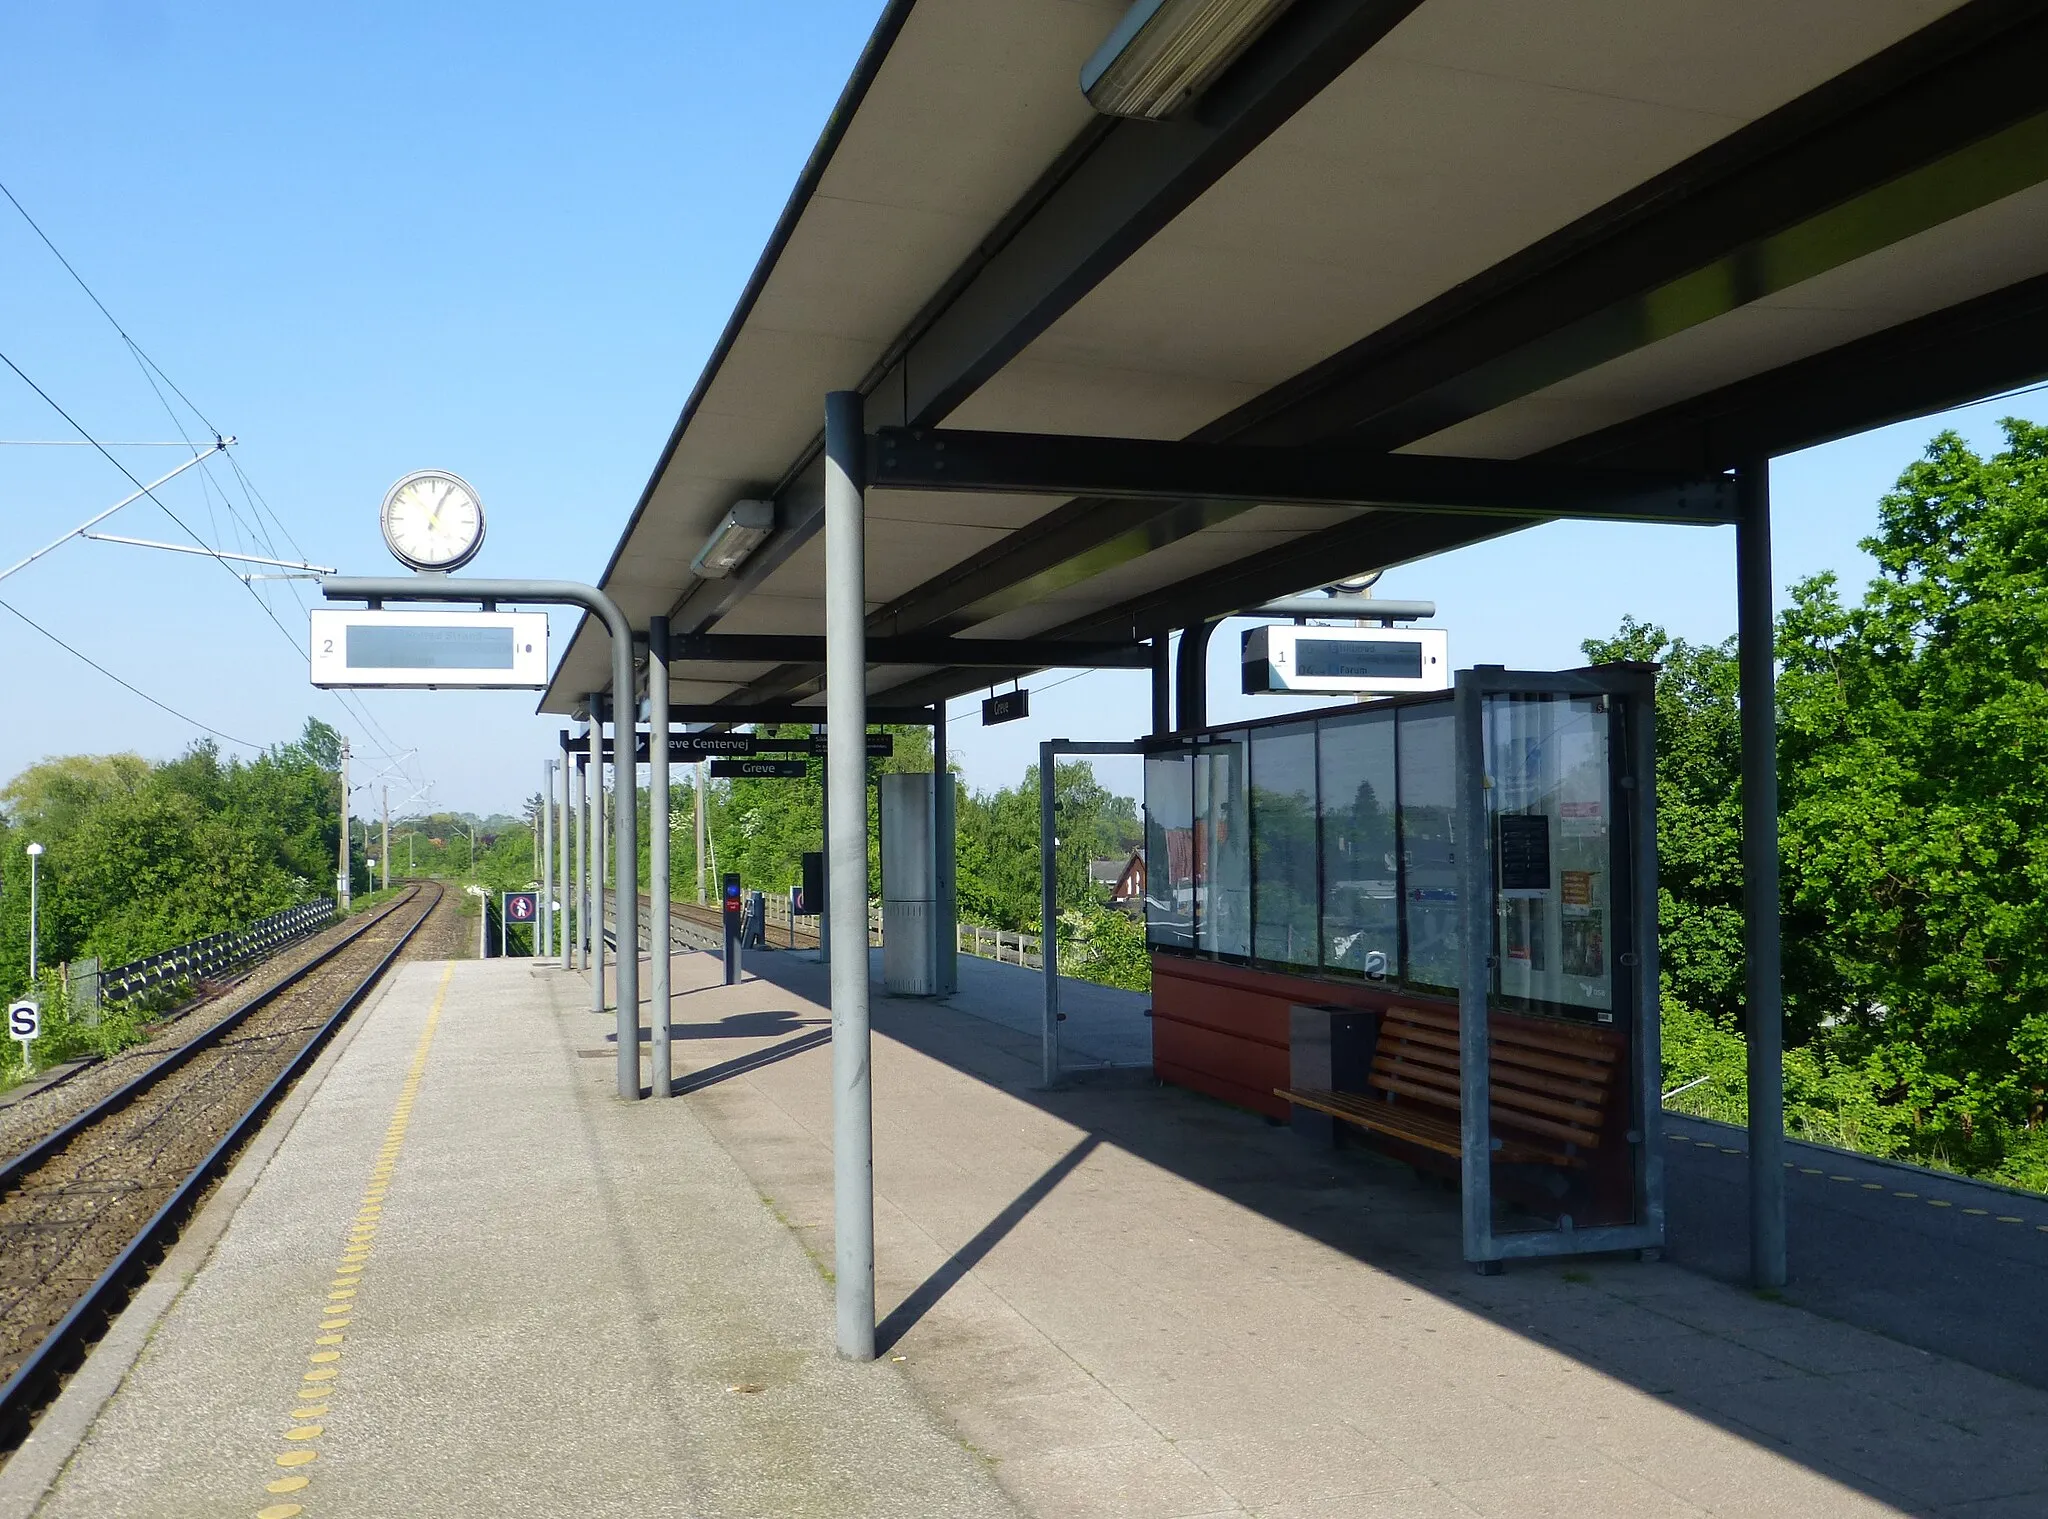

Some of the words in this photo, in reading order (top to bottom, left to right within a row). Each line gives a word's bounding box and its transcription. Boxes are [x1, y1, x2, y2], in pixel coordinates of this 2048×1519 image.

[323, 639, 333, 653] 2
[1278, 651, 1286, 663] 1
[994, 700, 1009, 716] Greve
[668, 740, 689, 749] eve
[692, 738, 749, 751] Centervej
[742, 763, 776, 773] Greve
[11, 1007, 36, 1035] S
